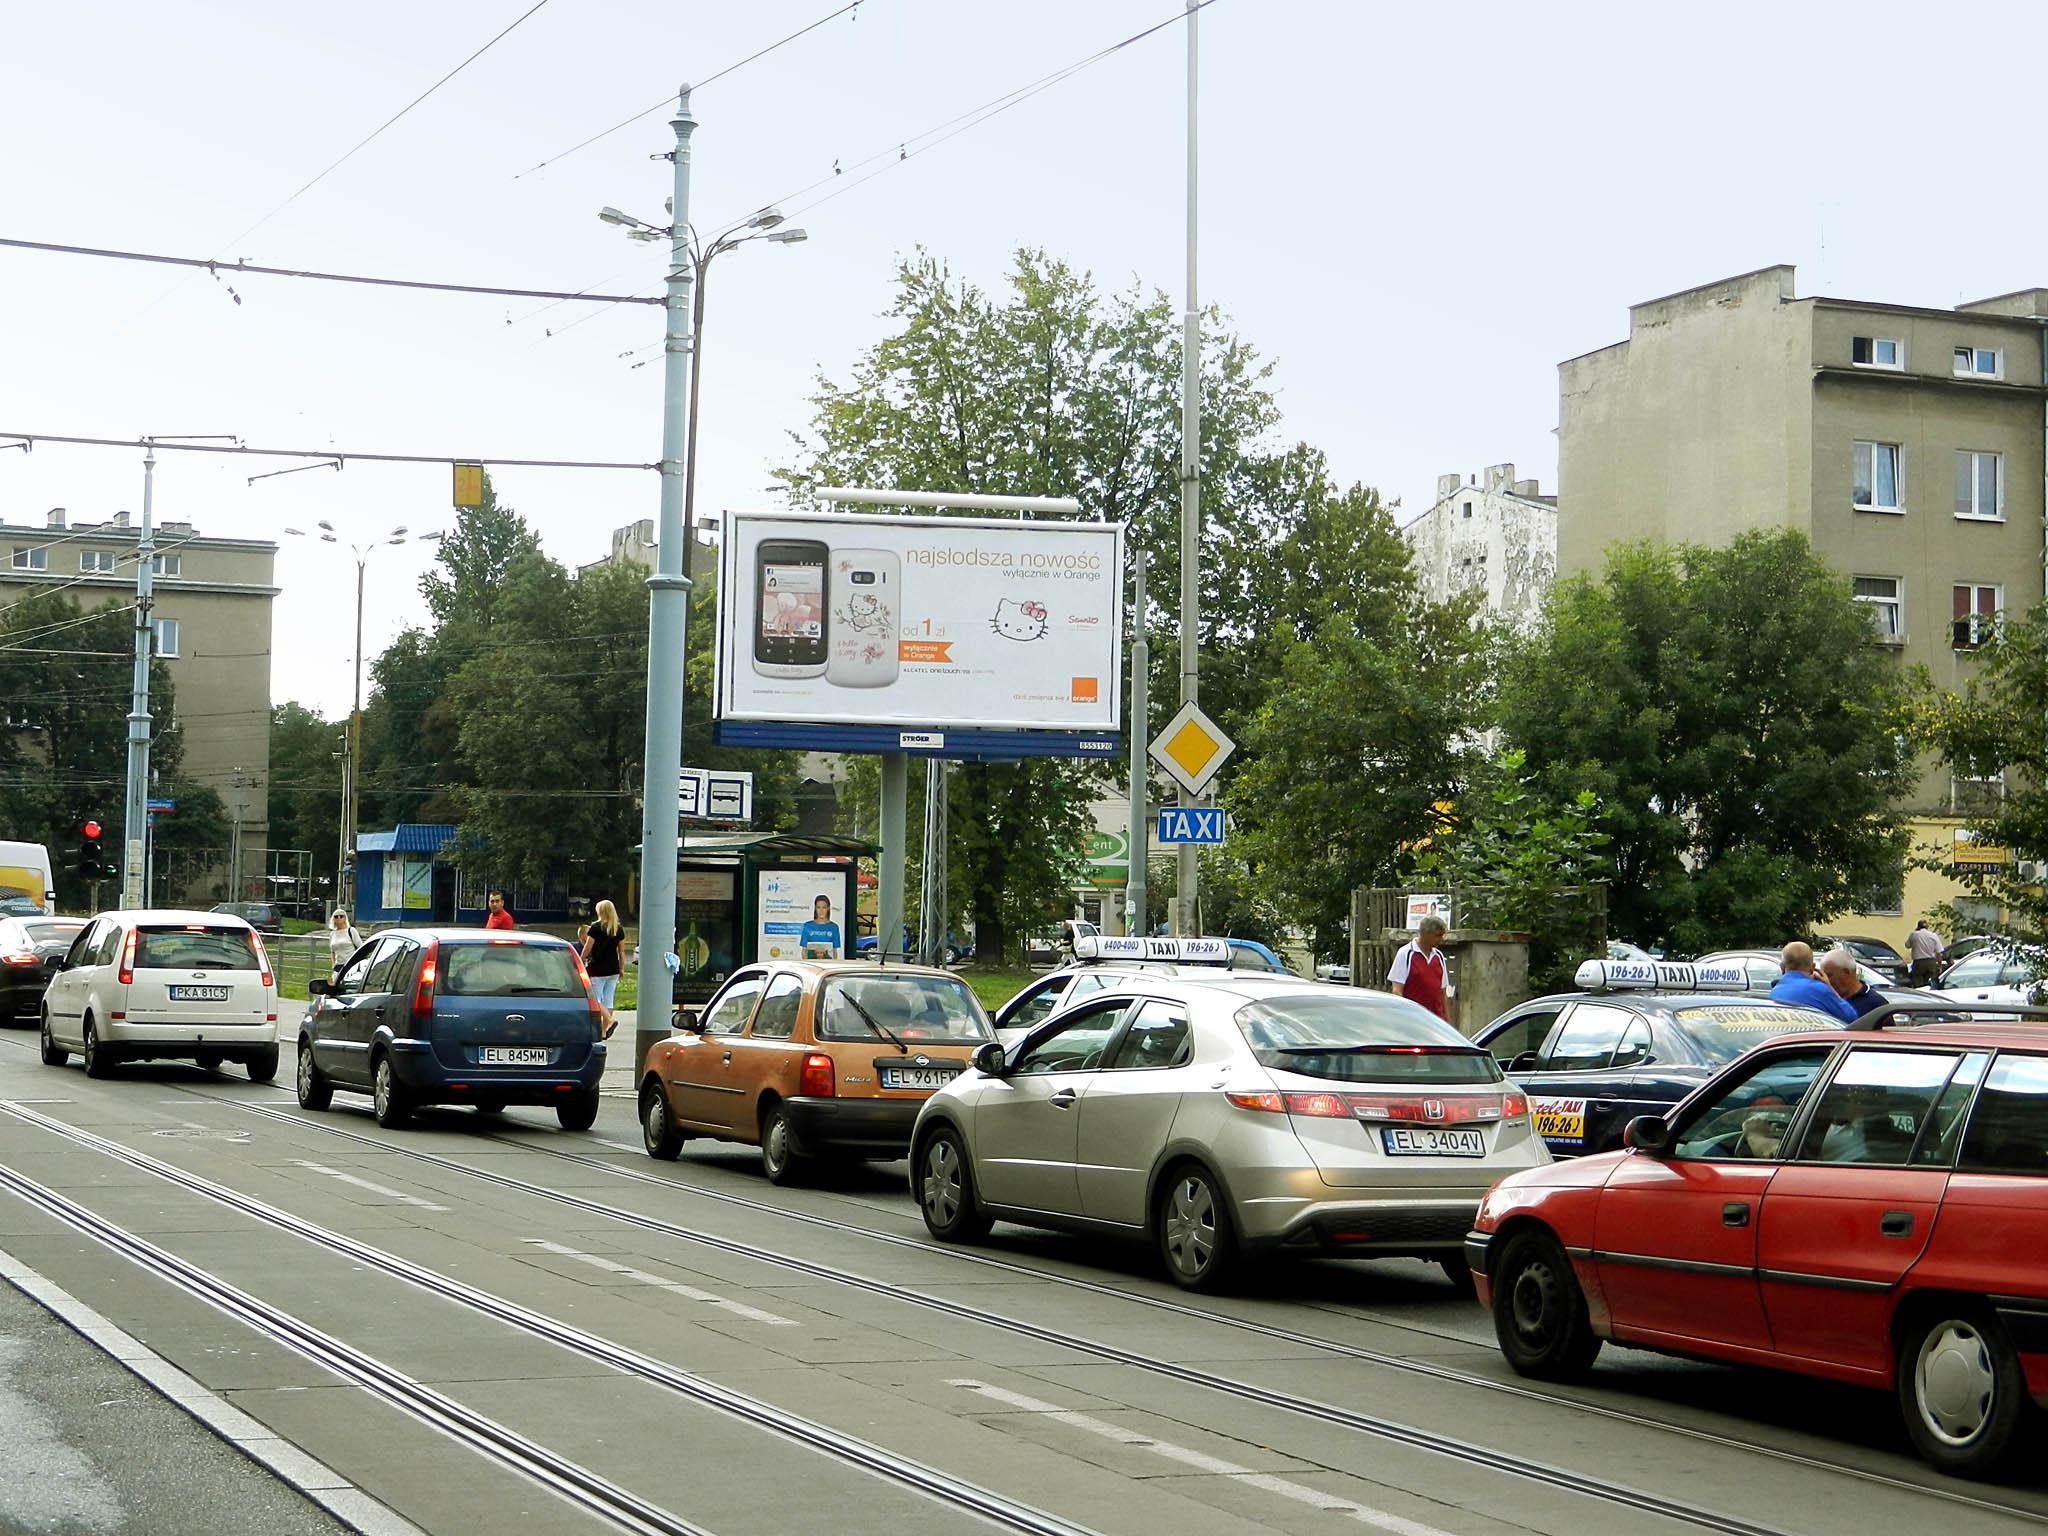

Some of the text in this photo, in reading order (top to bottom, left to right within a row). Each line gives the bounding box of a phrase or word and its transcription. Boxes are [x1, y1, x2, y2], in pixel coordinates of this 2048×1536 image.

[906, 547, 1100, 570] najsłodsza nowość
[1003, 568, 1100, 582] wyłącznie w Orange
[902, 618, 945, 637] od 1 zł
[1072, 695, 1095, 703] orange
[1161, 811, 1222, 840] TAXI
[1150, 943, 1176, 955] TAXI
[1659, 966, 1691, 983] TAXI
[177, 987, 199, 998] PKA
[1712, 1010, 1750, 1024] 800
[1752, 1010, 1786, 1023] 400
[486, 1049, 545, 1062] EL 845MM
[890, 1069, 910, 1084] EL
[1395, 1131, 1478, 1151] EL 3404V
